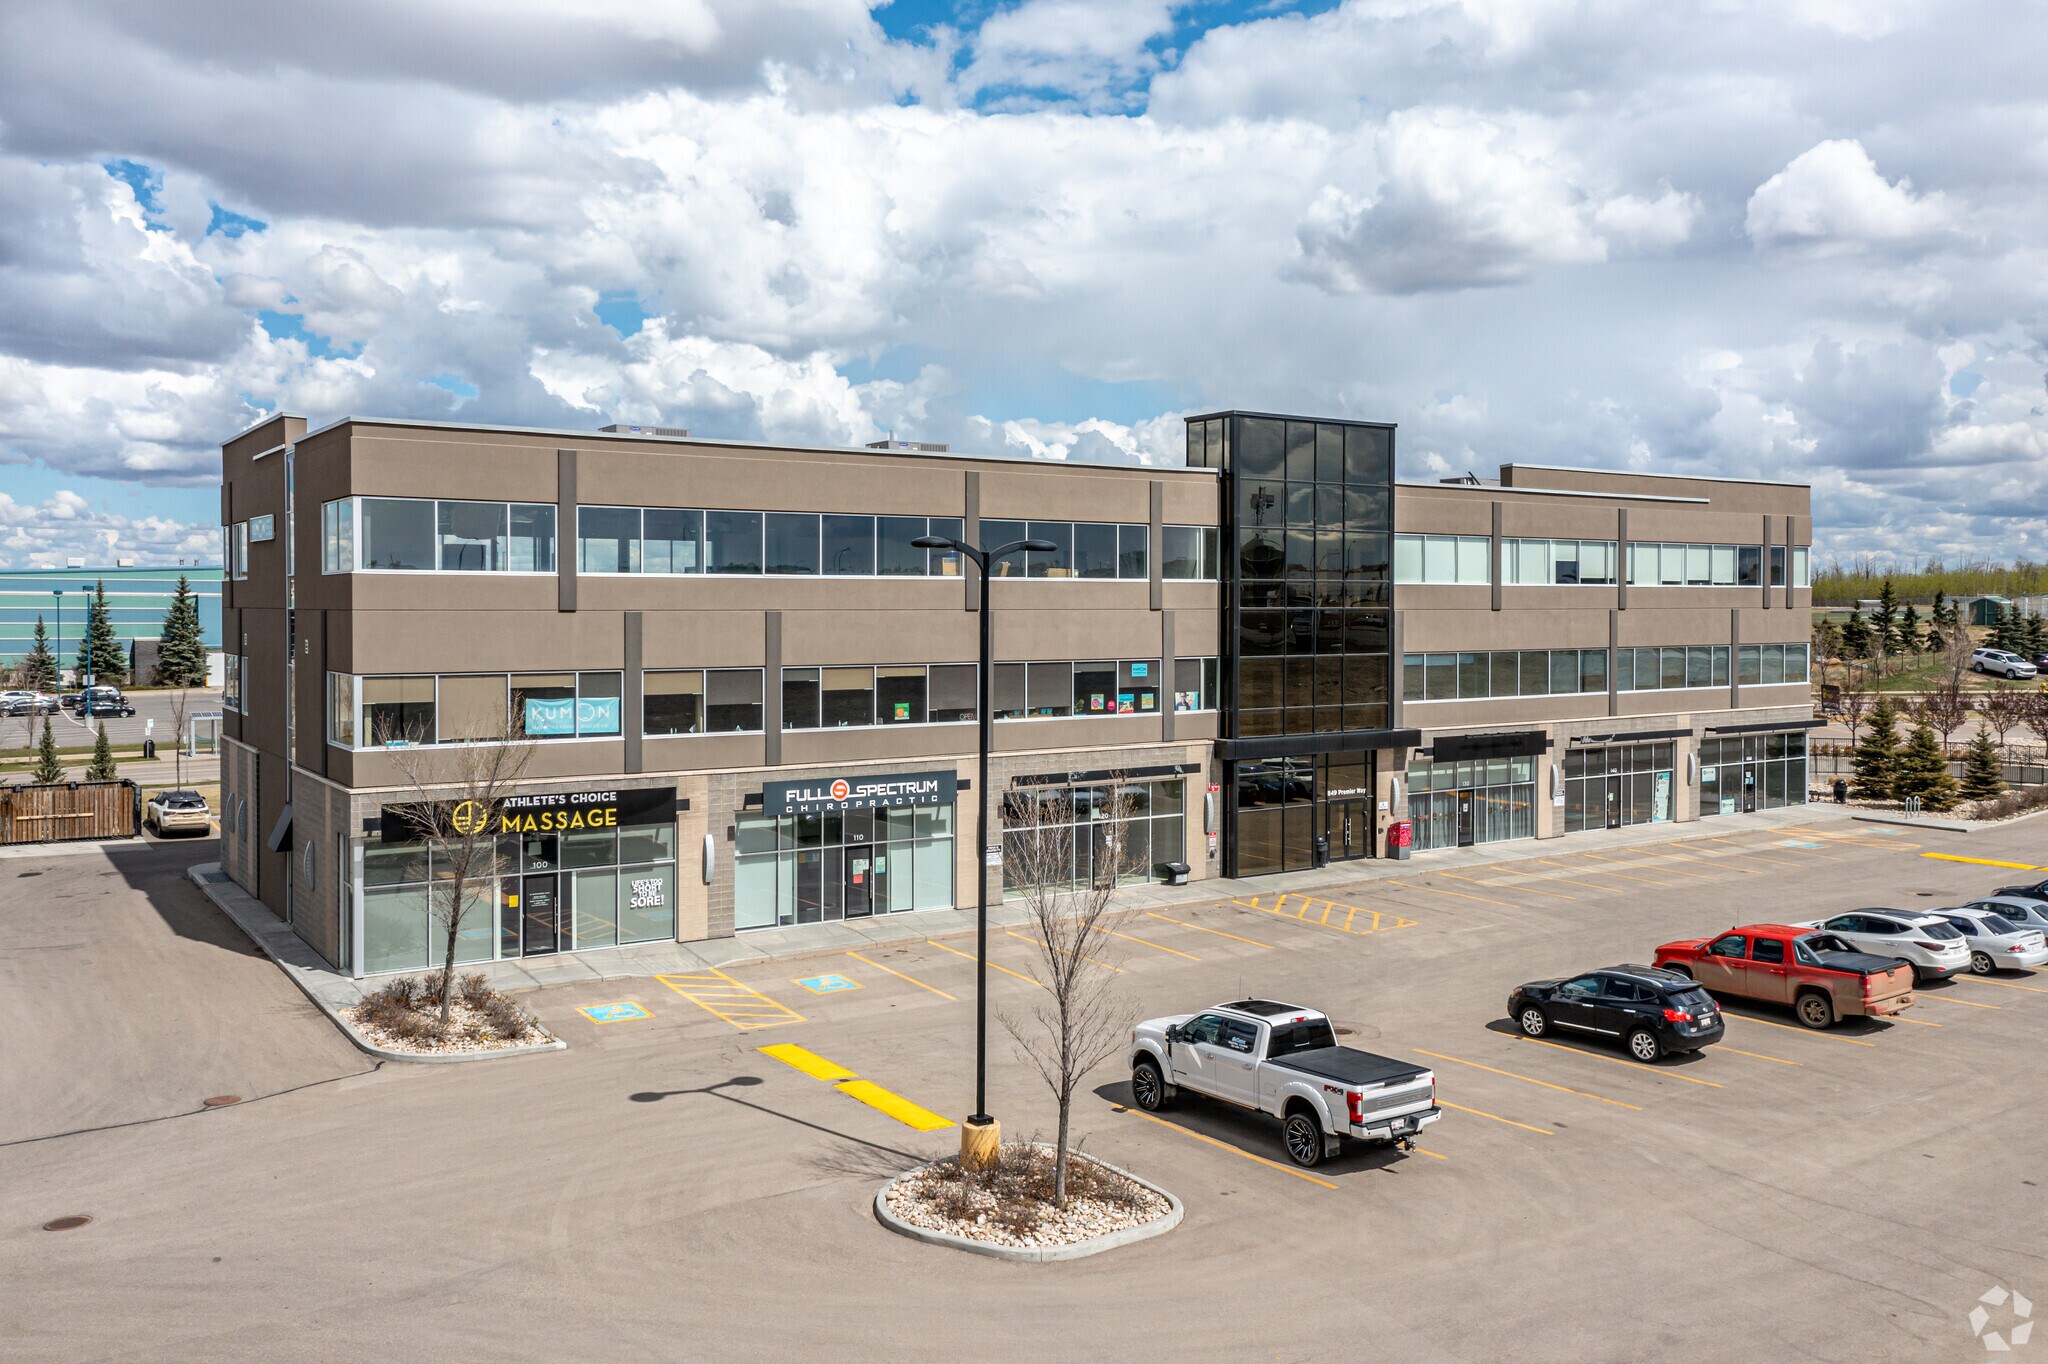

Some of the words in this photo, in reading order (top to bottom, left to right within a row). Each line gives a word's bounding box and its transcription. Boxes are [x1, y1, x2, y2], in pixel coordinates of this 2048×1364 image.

[531, 702, 610, 722] KUMON
[503, 794, 566, 808] ATHLETE'S
[571, 791, 617, 804] CHOICE
[786, 788, 831, 802] FULL
[855, 780, 938, 798] SPECTRUM
[786, 795, 938, 813] CHIROPRACTIC
[502, 808, 617, 833] MASSAGE
[532, 861, 548, 869] 100
[632, 883, 661, 893] SHORT
[630, 894, 664, 907] SORE!
